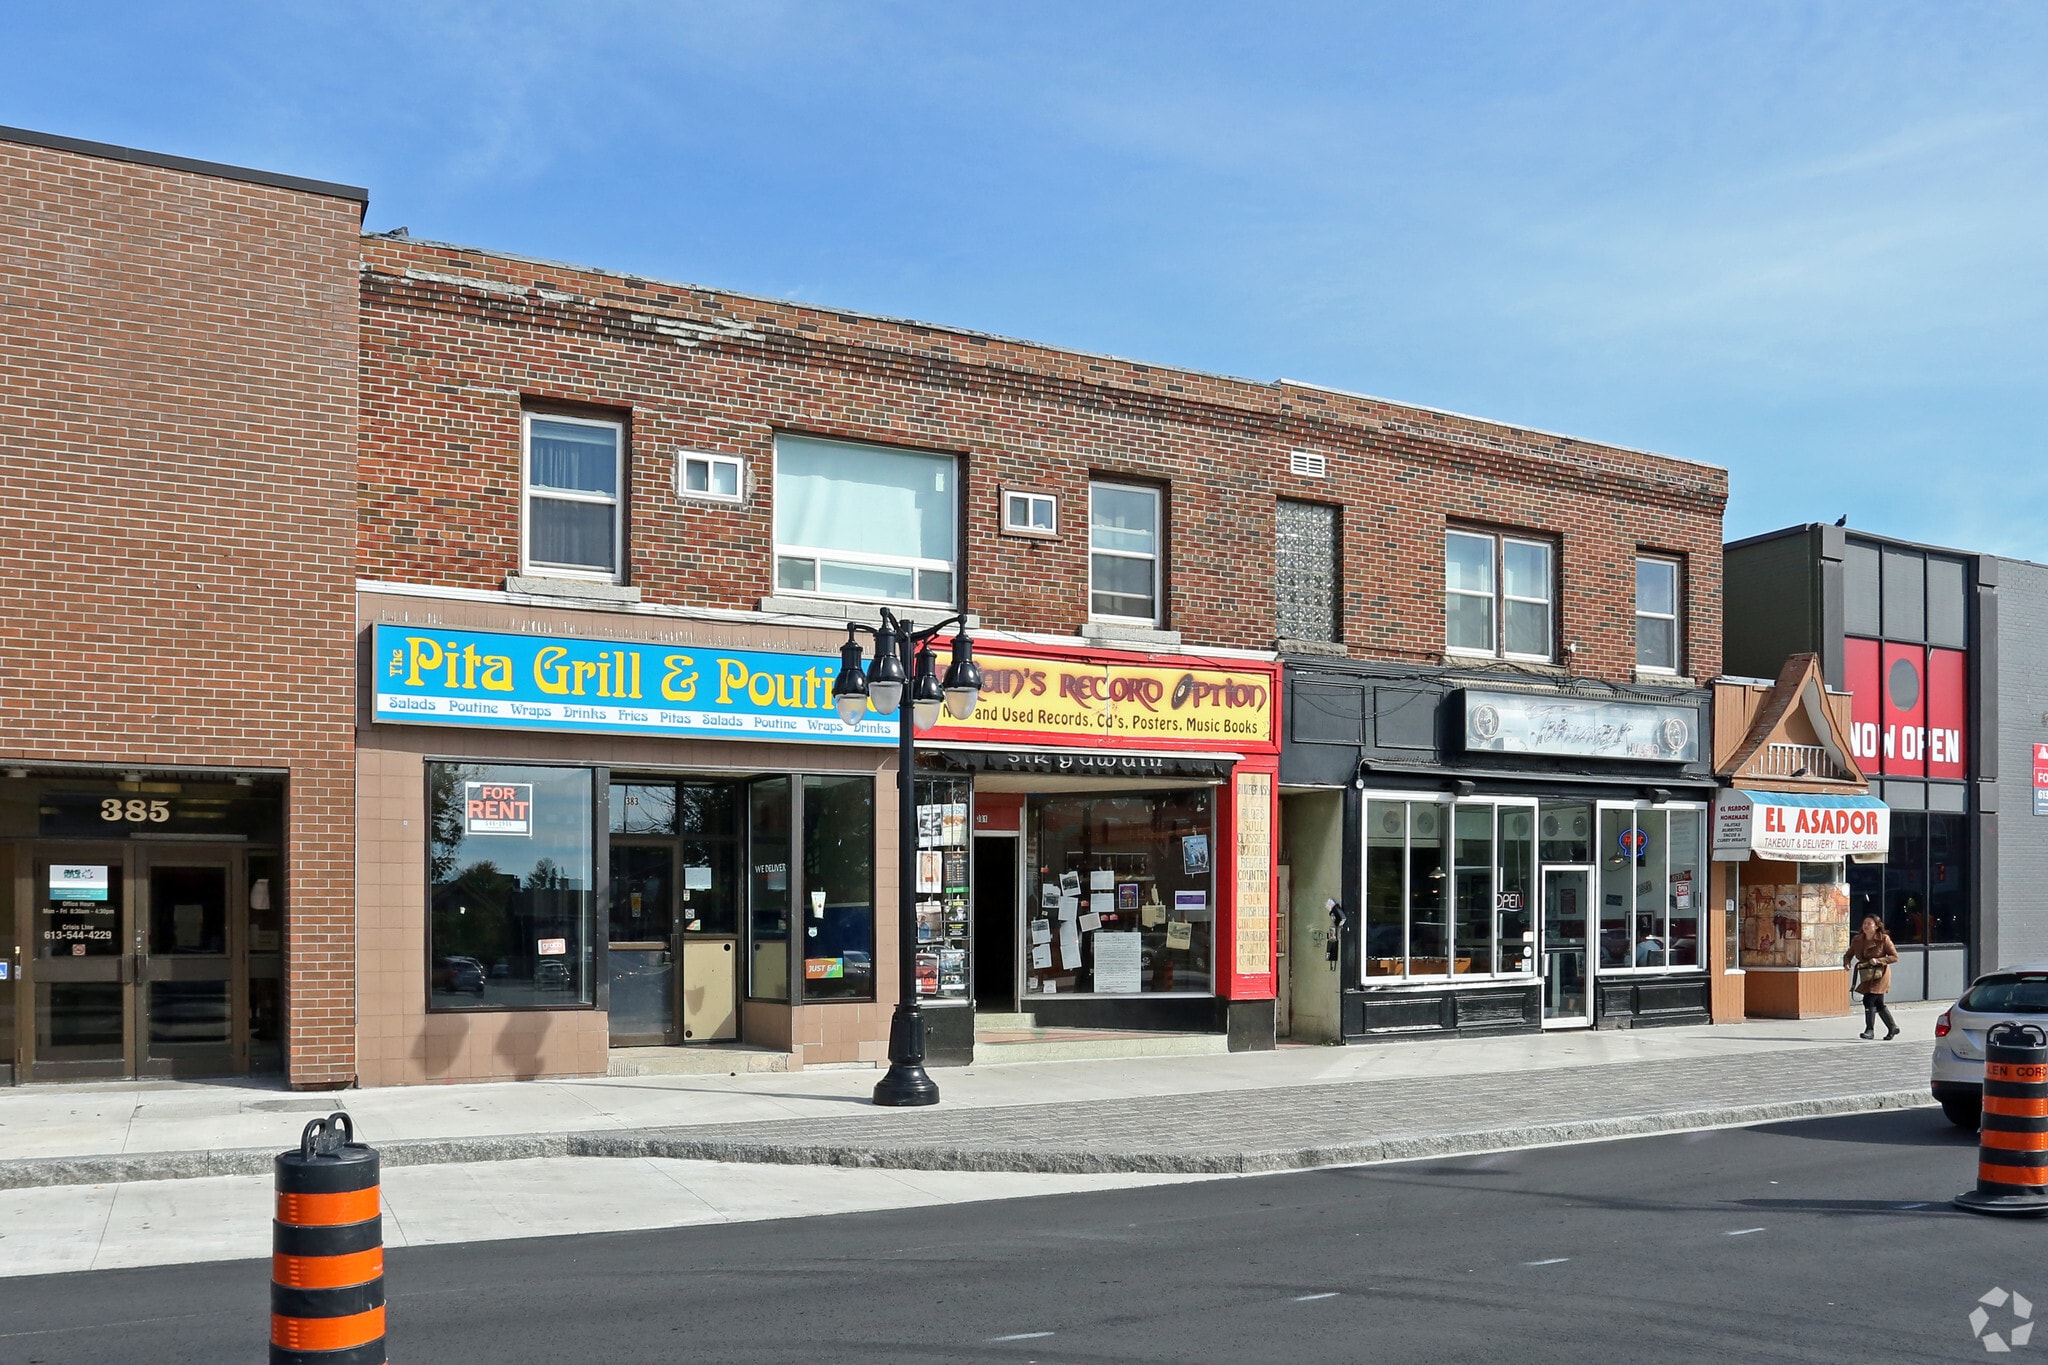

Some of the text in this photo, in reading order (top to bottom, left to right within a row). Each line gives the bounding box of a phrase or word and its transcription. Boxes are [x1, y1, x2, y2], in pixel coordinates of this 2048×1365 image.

[388, 648, 403, 678] The
[404, 636, 879, 713] Pita Grill & Pouti
[389, 696, 892, 735] Salads Poutine Wraps Drinks Fries Pitas Salads Poutine Wraps Drinks
[974, 706, 998, 721] and
[1002, 706, 1034, 724] Used
[1186, 717, 1220, 733] Music
[1224, 719, 1258, 735] Books
[1901, 725, 1960, 763] OPEN
[482, 786, 516, 800] FOR
[625, 796, 640, 806] 383
[101, 798, 170, 823] 385
[468, 800, 529, 820] RENT
[1765, 807, 1878, 835] EL ASADOR
[1764, 837, 1796, 849] TAKEOUT
[1796, 839, 1801, 849] &
[1802, 839, 1834, 850] DELIVERY
[754, 862, 787, 873] WE DELIVER
[1496, 893, 1524, 909] OPEN
[44, 930, 112, 940] 613-544-4229
[808, 964, 841, 973] JUST EAT
